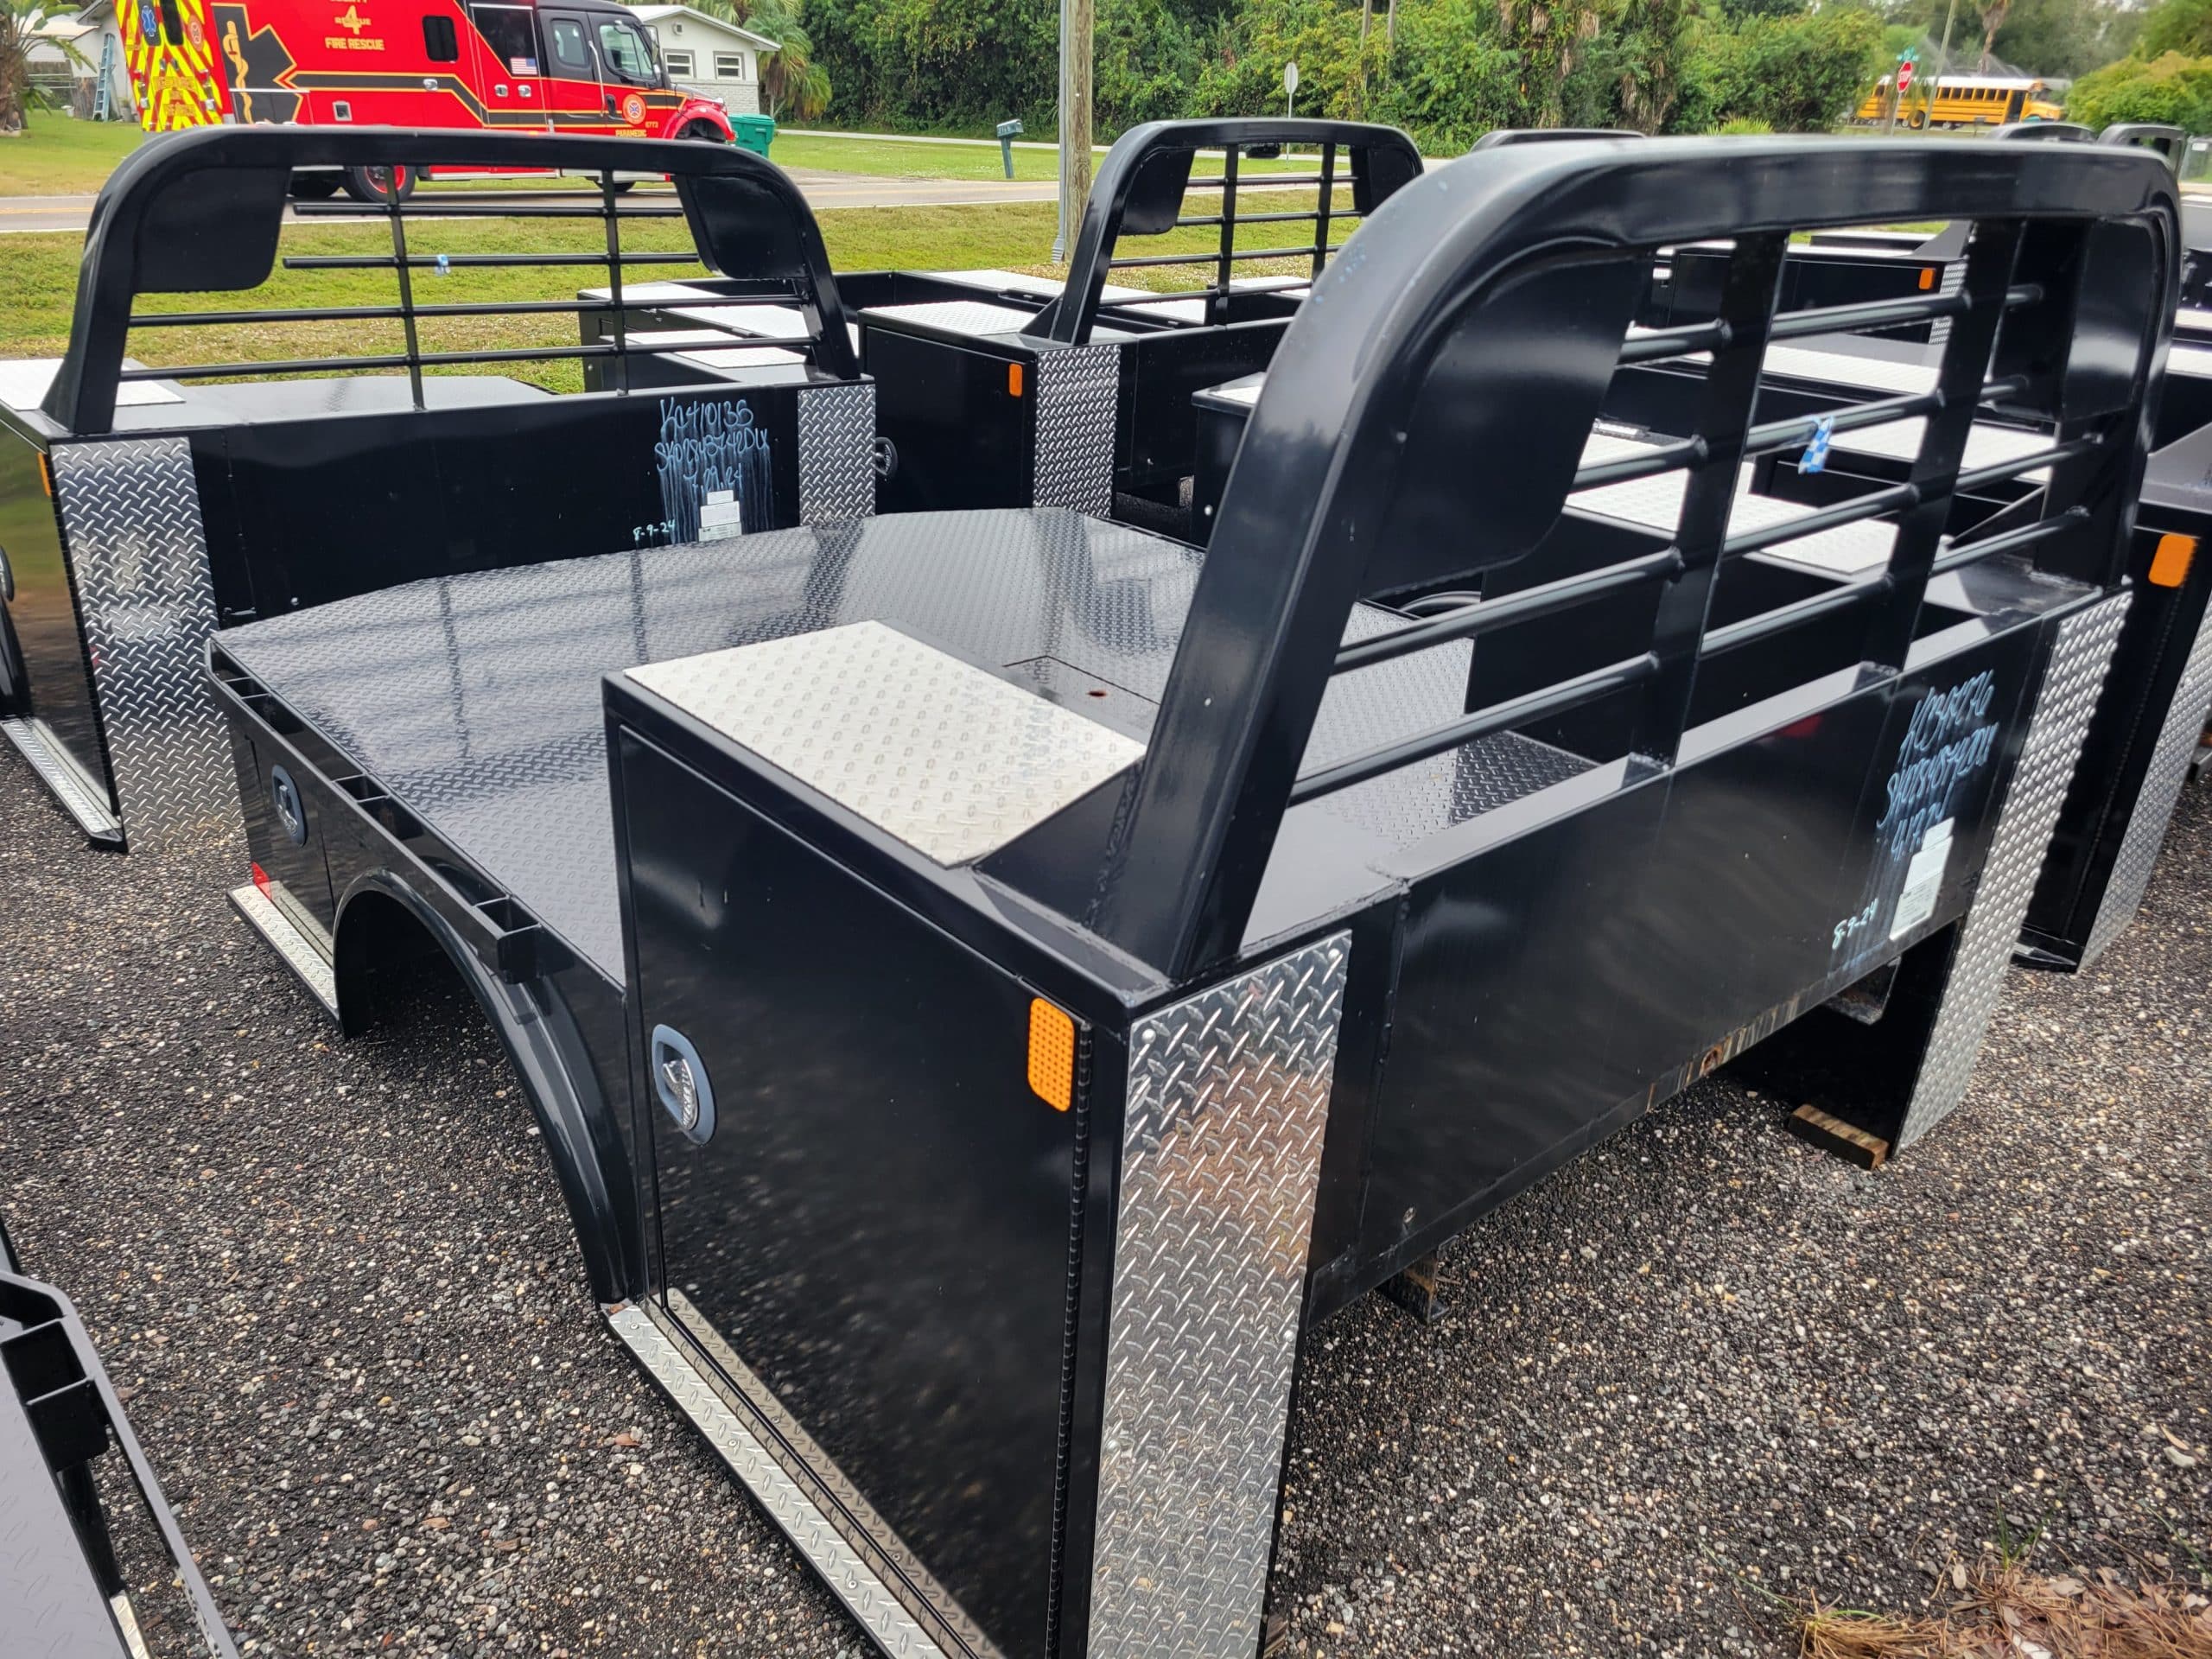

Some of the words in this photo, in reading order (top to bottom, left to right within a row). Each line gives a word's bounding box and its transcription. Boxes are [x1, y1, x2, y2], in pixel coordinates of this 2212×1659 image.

[341, 4, 360, 35] 4
[324, 37, 347, 49] FIRE
[347, 38, 385, 50] RESCUE
[632, 518, 676, 542] 8-9-24
